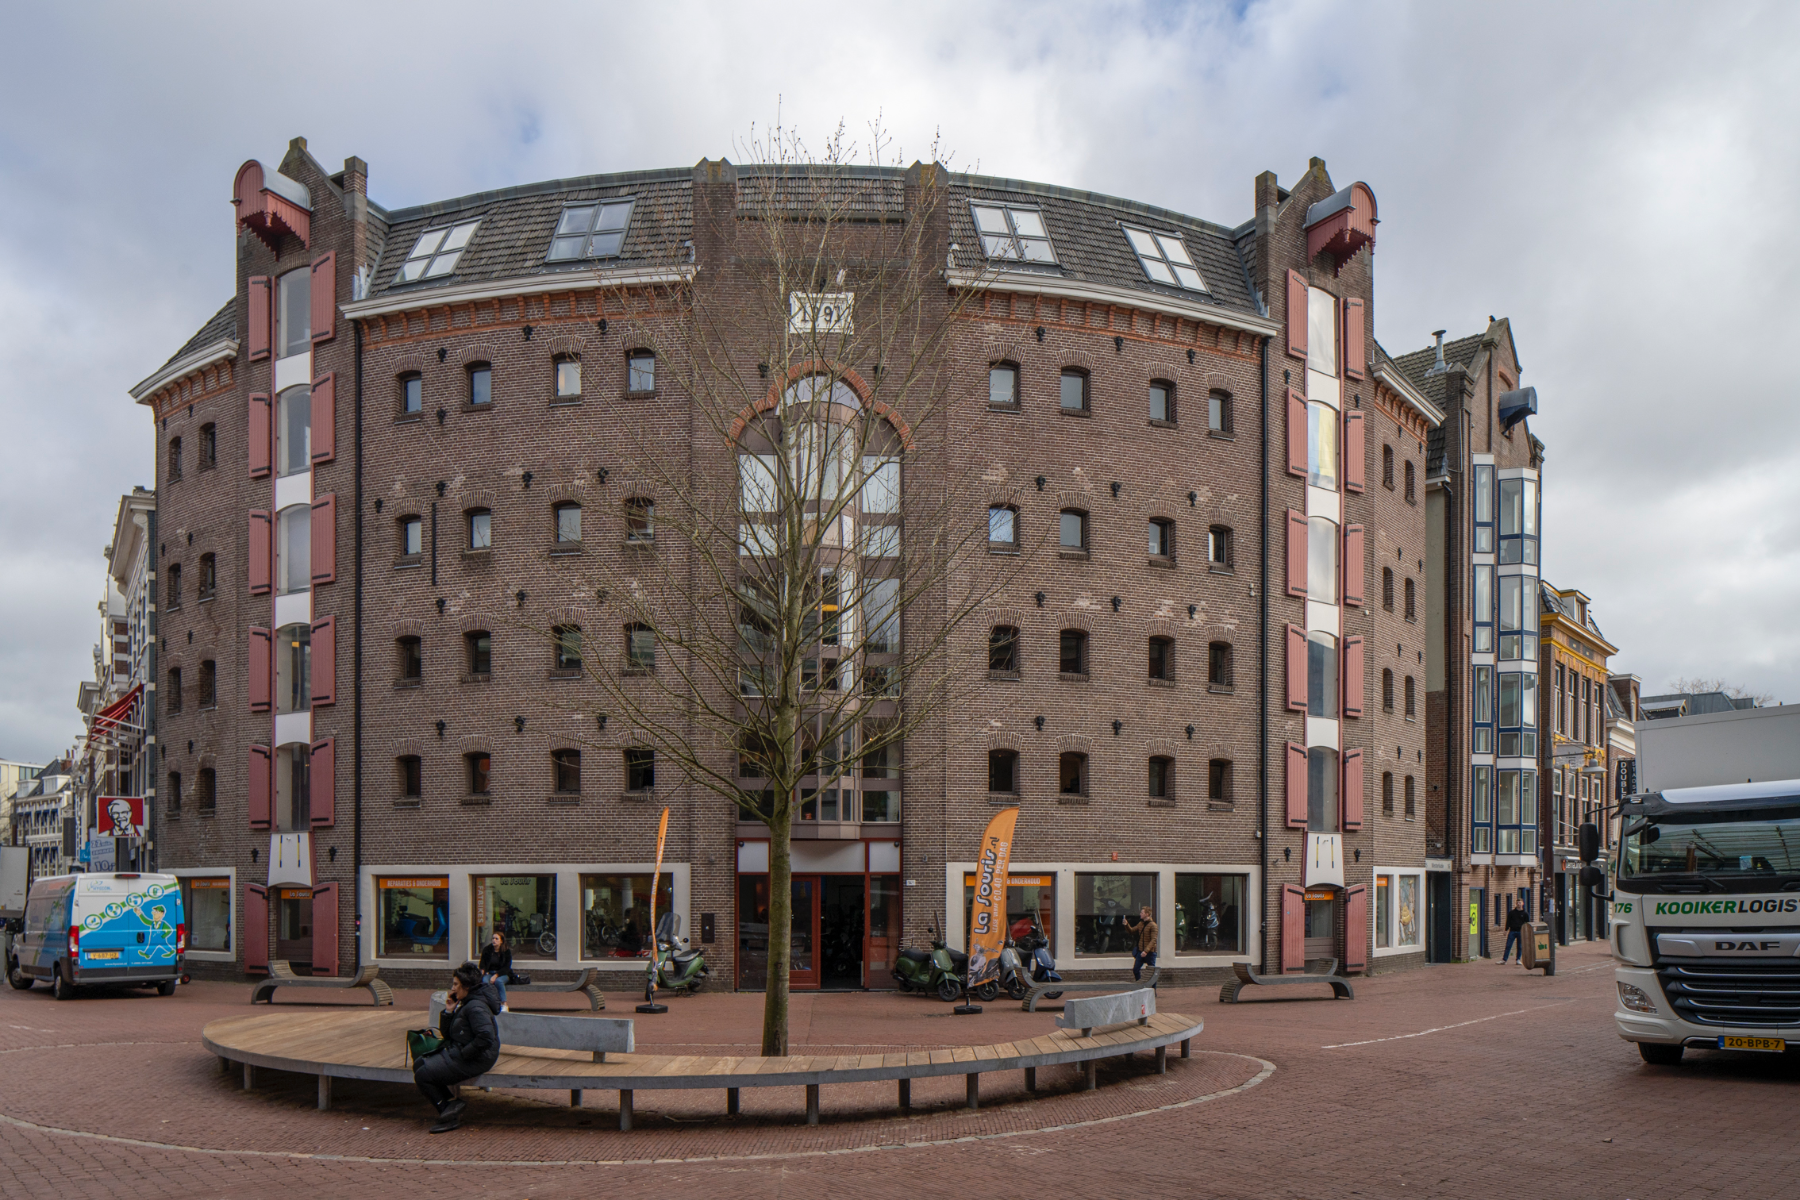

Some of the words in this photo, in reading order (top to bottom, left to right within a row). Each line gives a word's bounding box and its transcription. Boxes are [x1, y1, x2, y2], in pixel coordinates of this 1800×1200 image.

[999, 841, 1009, 858] DAG
[996, 859, 1005, 875] PER
[974, 912, 991, 935] La
[1715, 941, 1781, 951] DAF
[1728, 1037, 1781, 1049] 20-BPB-7
